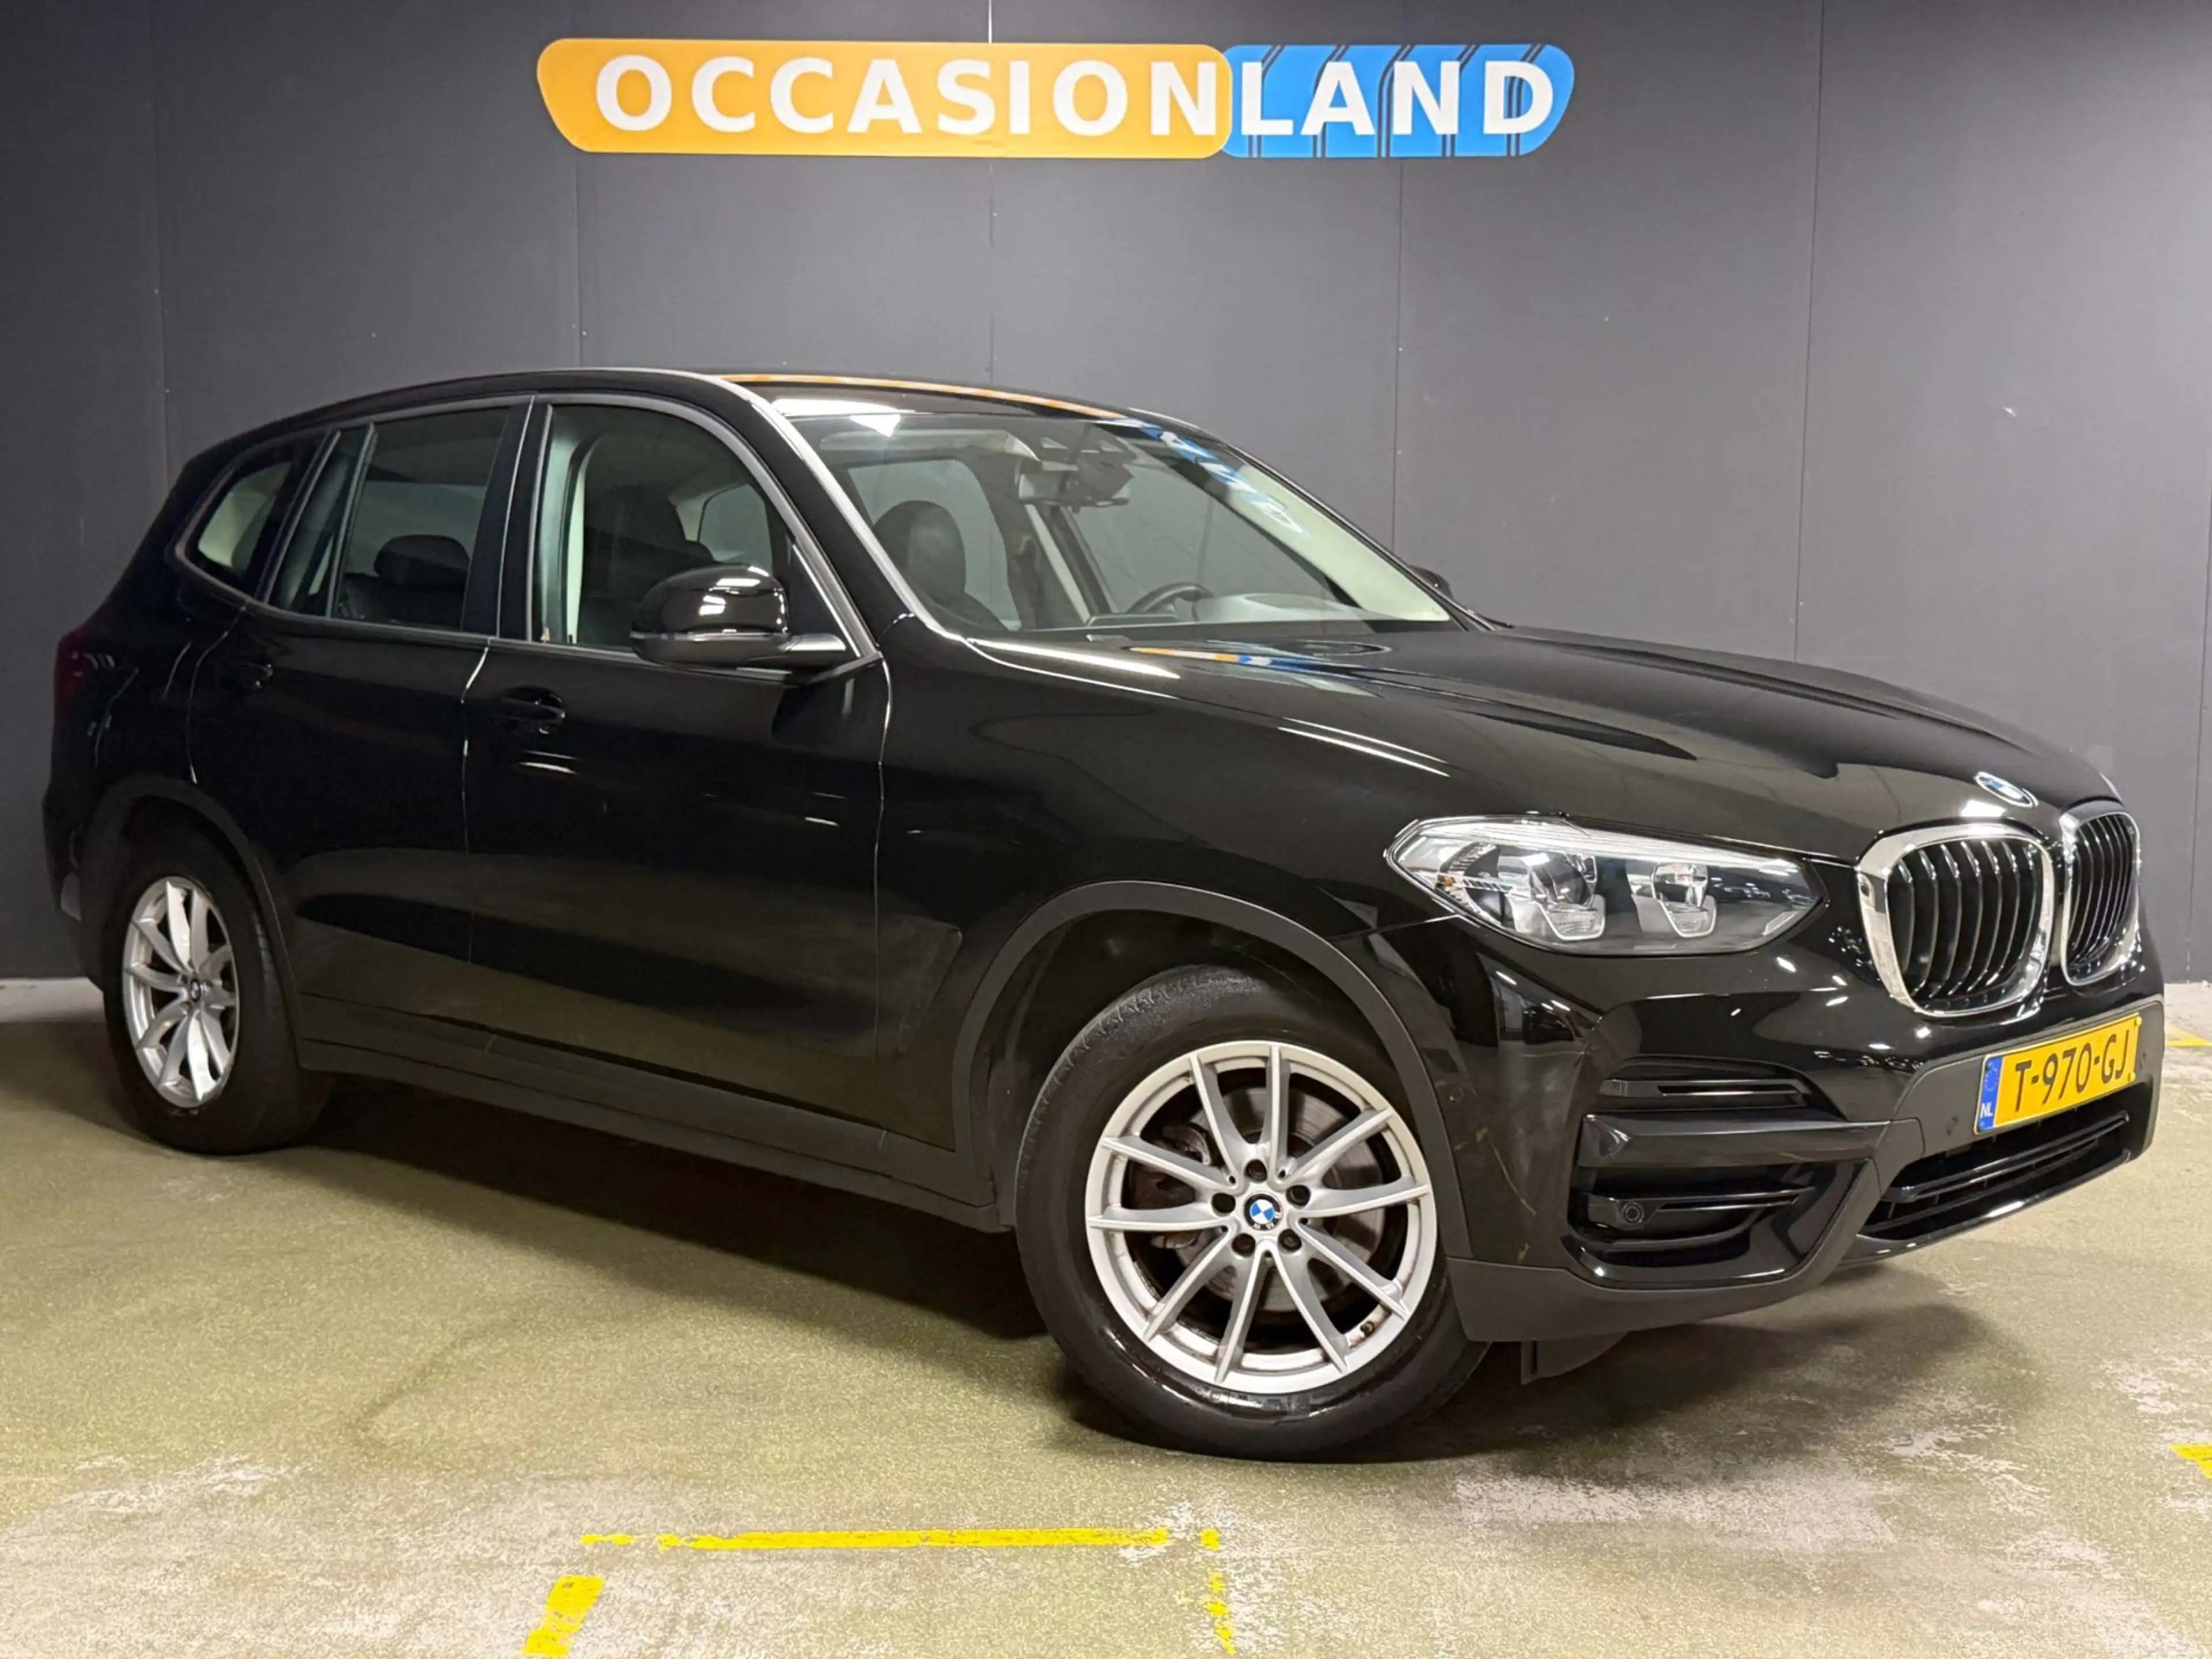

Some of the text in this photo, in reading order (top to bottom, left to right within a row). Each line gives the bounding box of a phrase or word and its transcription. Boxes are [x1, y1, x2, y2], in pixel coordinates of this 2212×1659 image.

[597, 56, 1553, 136] OCCASIONLAND
[1980, 1102, 1994, 1118] NL
[2014, 1029, 2130, 1112] T-970-GJ
